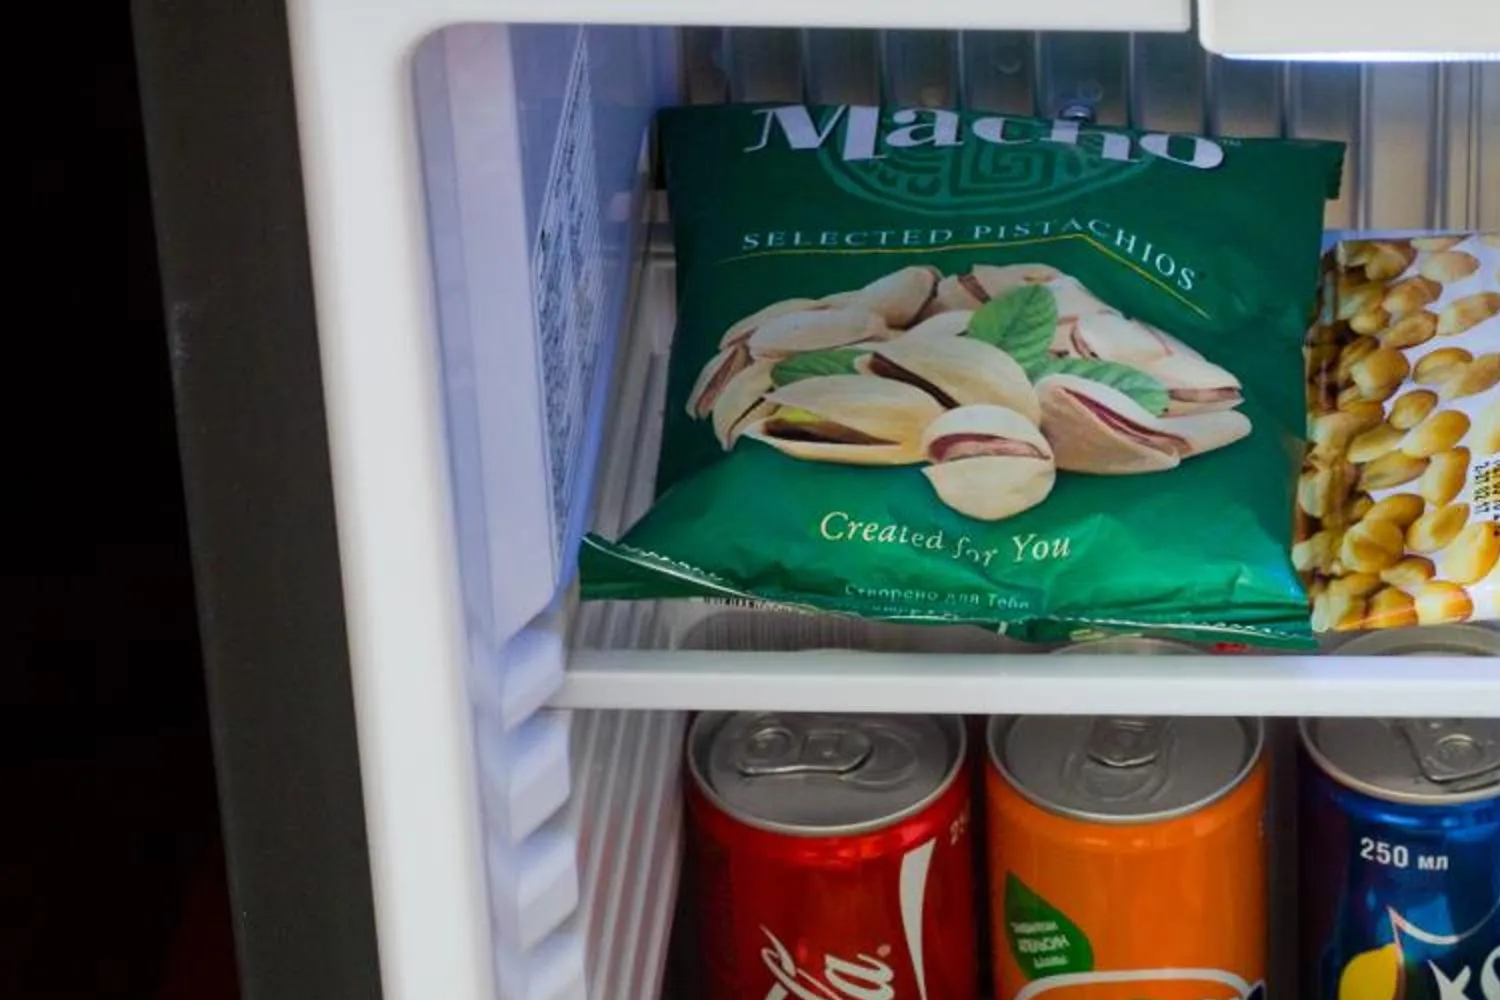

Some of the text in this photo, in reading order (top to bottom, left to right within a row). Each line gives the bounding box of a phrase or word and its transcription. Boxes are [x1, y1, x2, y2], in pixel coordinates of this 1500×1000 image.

[744, 104, 1224, 170] Macho
[742, 219, 1196, 291] SELECTED PISTACHIOS
[819, 511, 1071, 570] Created for You
[1360, 837, 1449, 871] 250 мл
